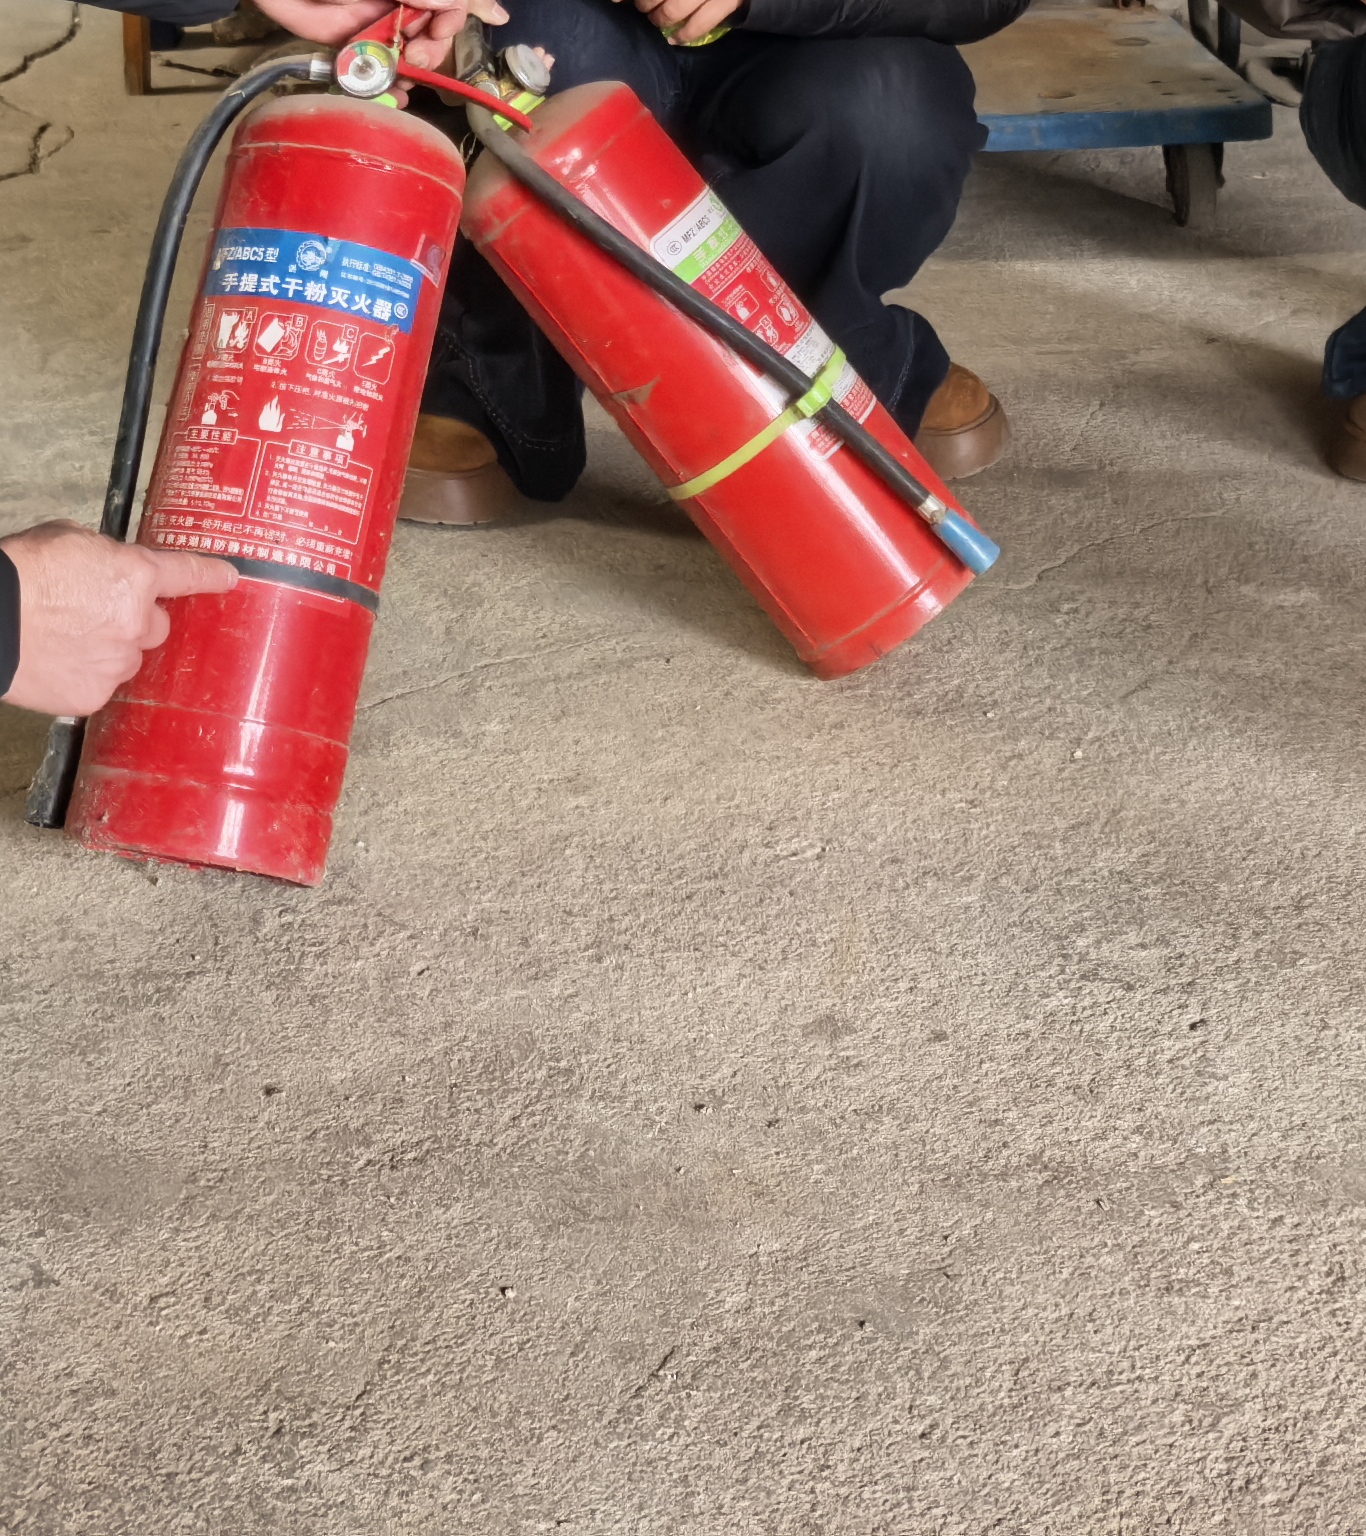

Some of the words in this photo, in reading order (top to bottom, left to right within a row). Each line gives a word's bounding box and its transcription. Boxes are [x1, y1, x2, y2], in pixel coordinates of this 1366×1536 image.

[222, 272, 392, 322] 手提式干粉灭火器
[296, 316, 304, 327] B
[346, 328, 355, 339] C
[189, 428, 232, 442] 主要性能
[296, 443, 346, 465] 注意事项
